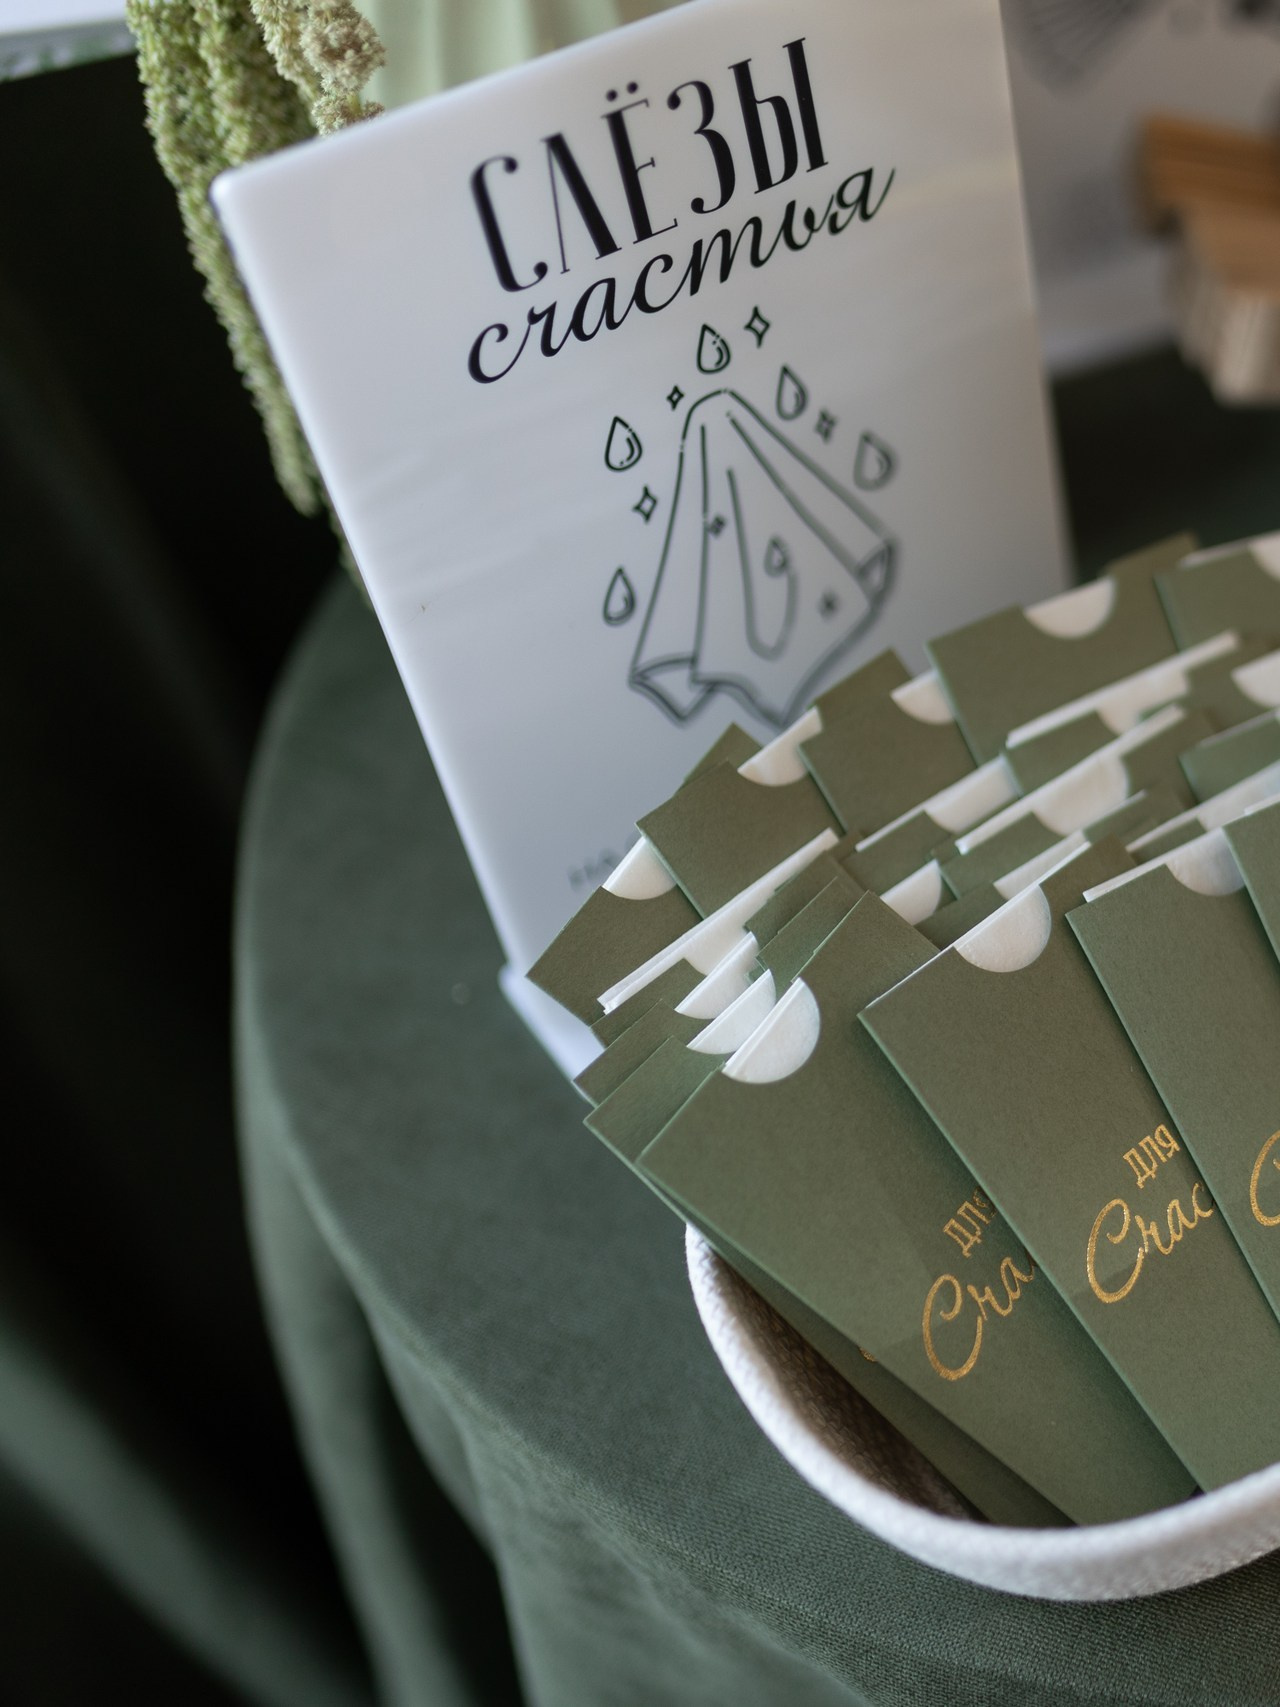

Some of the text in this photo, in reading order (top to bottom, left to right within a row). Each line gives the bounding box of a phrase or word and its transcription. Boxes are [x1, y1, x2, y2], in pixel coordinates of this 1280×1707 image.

[470, 37, 829, 292] СЛЁЗЫ
[467, 167, 896, 384] счастья
[922, 1252, 1038, 1381] Сча
